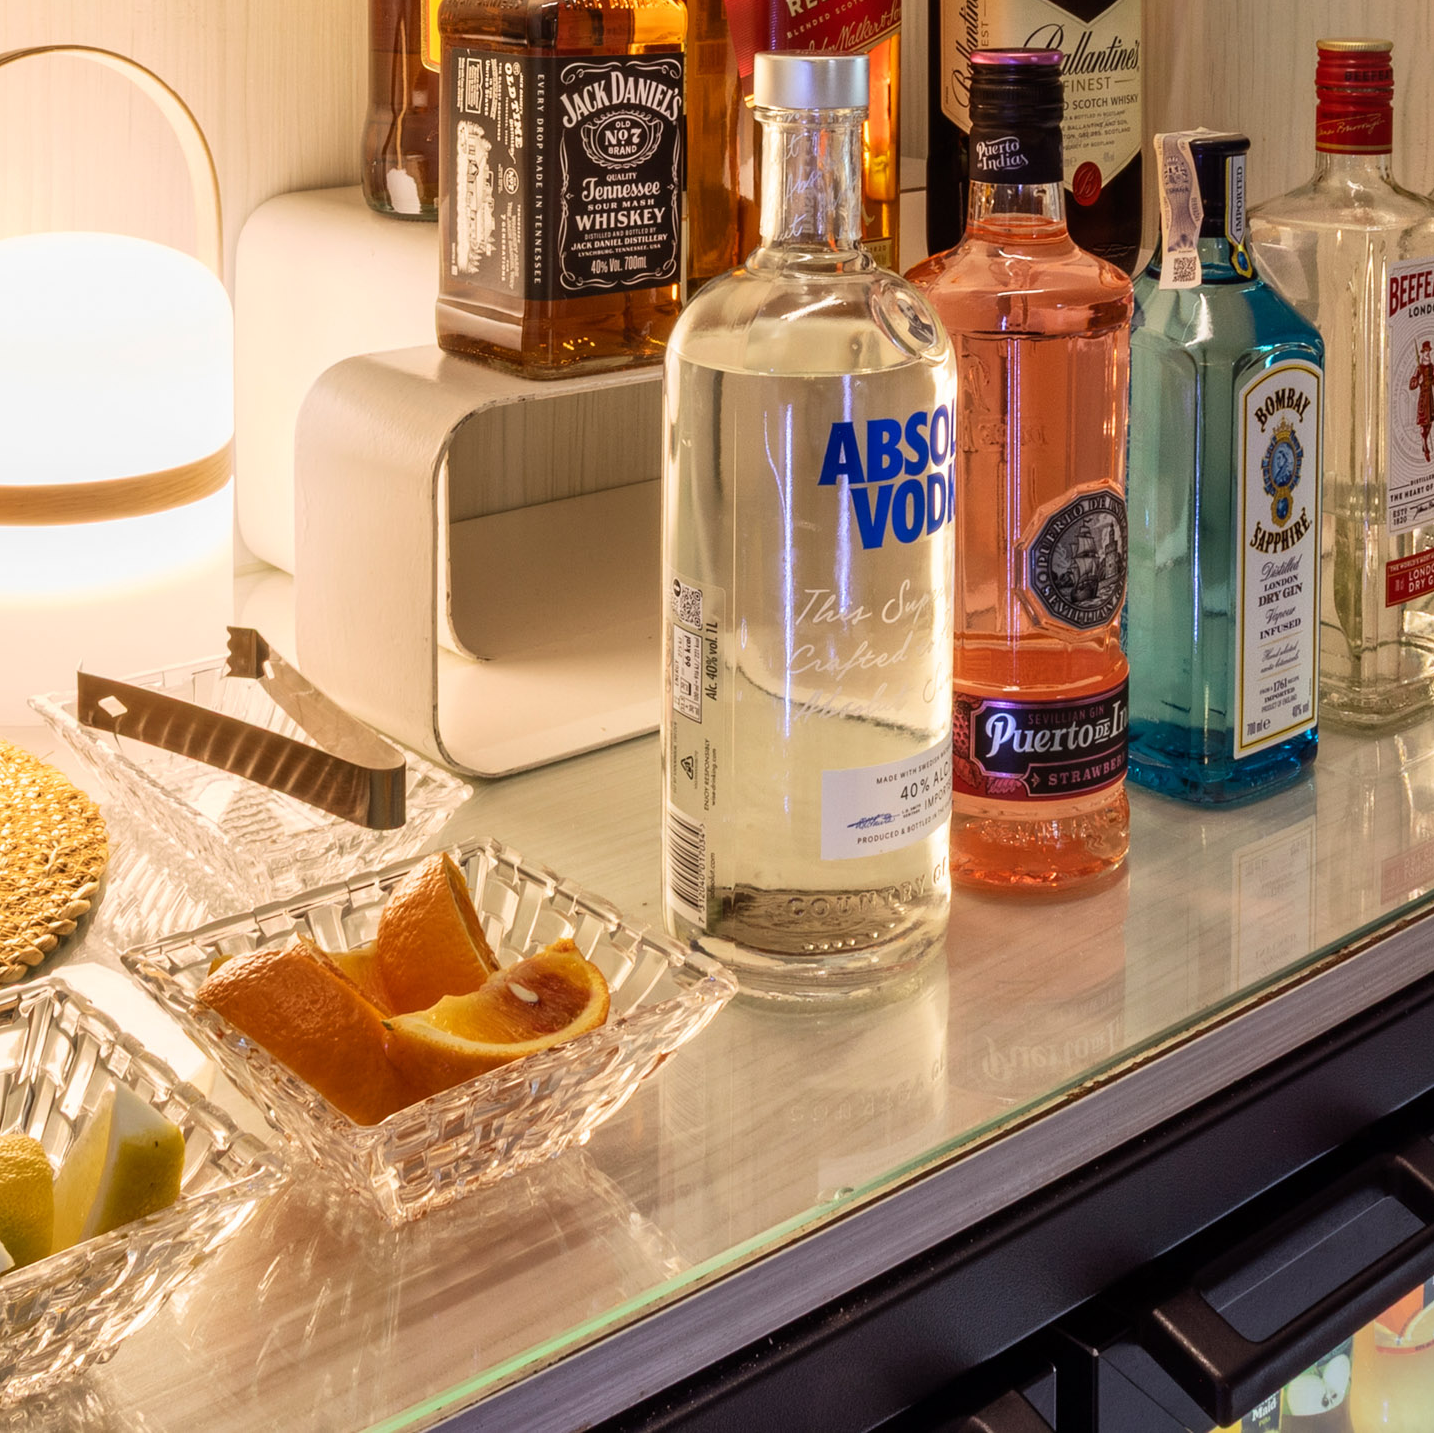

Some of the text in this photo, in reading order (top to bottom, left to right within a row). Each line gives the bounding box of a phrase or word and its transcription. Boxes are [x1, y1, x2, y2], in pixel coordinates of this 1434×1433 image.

[786, 13, 831, 39] BLENDED
[536, 74, 545, 111] EVERY
[560, 71, 682, 128] JACK DANIEL'S
[1072, 97, 1108, 110] SCOTCH
[1110, 93, 1139, 107] WHISKY
[505, 62, 523, 148] OLD TIME
[536, 118, 544, 149] DROP
[1067, 123, 1104, 132] BALLANTINE
[608, 145, 637, 155] BRAND
[976, 136, 1020, 160] Puerto
[982, 154, 1028, 171] Indias
[606, 172, 637, 182] QUALITY
[535, 195, 543, 208] IN
[581, 177, 661, 202] Tennessee
[1235, 166, 1243, 232] IMPORTED
[587, 198, 655, 211] SOUR MASH
[575, 207, 666, 231] WHISKEY
[571, 233, 668, 251] JACK DANIEL DISTILLERY
[584, 231, 612, 240] DISTILLED
[625, 228, 649, 236] BOTTLED
[534, 215, 543, 284] TENNESSEE
[591, 259, 609, 274] 40%
[1254, 387, 1311, 433] BOMBAY
[1390, 492, 1403, 502] THE
[1405, 487, 1424, 498] HEART
[1425, 482, 1433, 492] OF
[1410, 474, 1434, 486] DISTILLED
[1037, 497, 1107, 567] PUERTO DE
[1249, 507, 1311, 554] SAPPHIRE
[1260, 554, 1303, 582] Distilled
[1258, 582, 1303, 607] DRY GIN
[1264, 573, 1298, 592] LONDON
[1408, 580, 1425, 593] DRY
[795, 589, 872, 625] This
[1265, 606, 1296, 625] Vapour
[1260, 617, 1301, 640] INFUSED
[704, 637, 717, 655] vol.
[790, 630, 914, 681] Crafted
[685, 656, 691, 667] 66
[705, 655, 717, 680] 40%
[704, 682, 717, 701] Alc.
[1264, 686, 1295, 704] IMPORTED
[1273, 677, 1288, 693] 1761
[1028, 704, 1104, 725] SEVILLIAN GIN
[985, 713, 1094, 758] Puerto
[1094, 718, 1111, 743] DE
[876, 756, 940, 785] MADE WITH SWEDISH
[900, 777, 930, 801] 40%
[857, 829, 900, 844] PRODUCED
[901, 827, 905, 835] &
[907, 816, 931, 833] BOTTLED
[787, 873, 926, 917] COUNTRY
[1251, 1397, 1277, 1422] Maid
